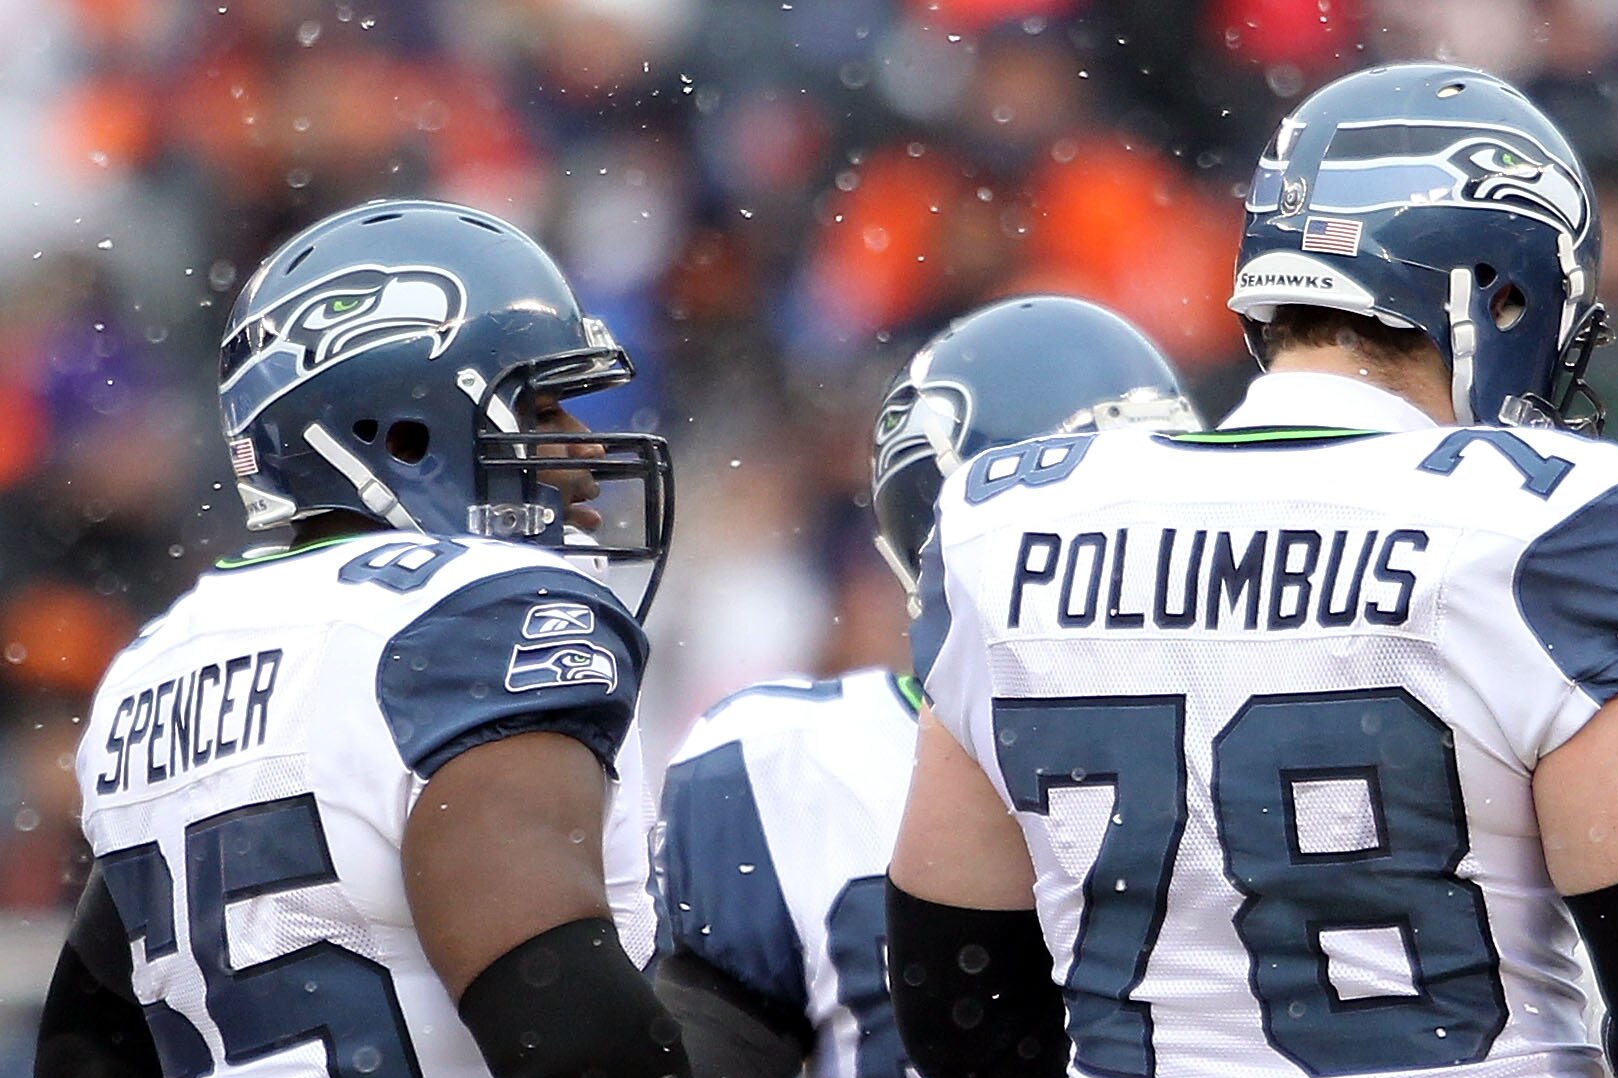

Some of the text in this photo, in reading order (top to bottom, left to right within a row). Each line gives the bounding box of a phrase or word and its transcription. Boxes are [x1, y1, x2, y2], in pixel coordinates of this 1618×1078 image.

[1240, 273, 1333, 289] SEAHAWKS
[964, 434, 1098, 507] 8
[1415, 429, 1576, 502] 7
[1008, 527, 1430, 631] POLUMBUS
[96, 648, 283, 796] SPENCER
